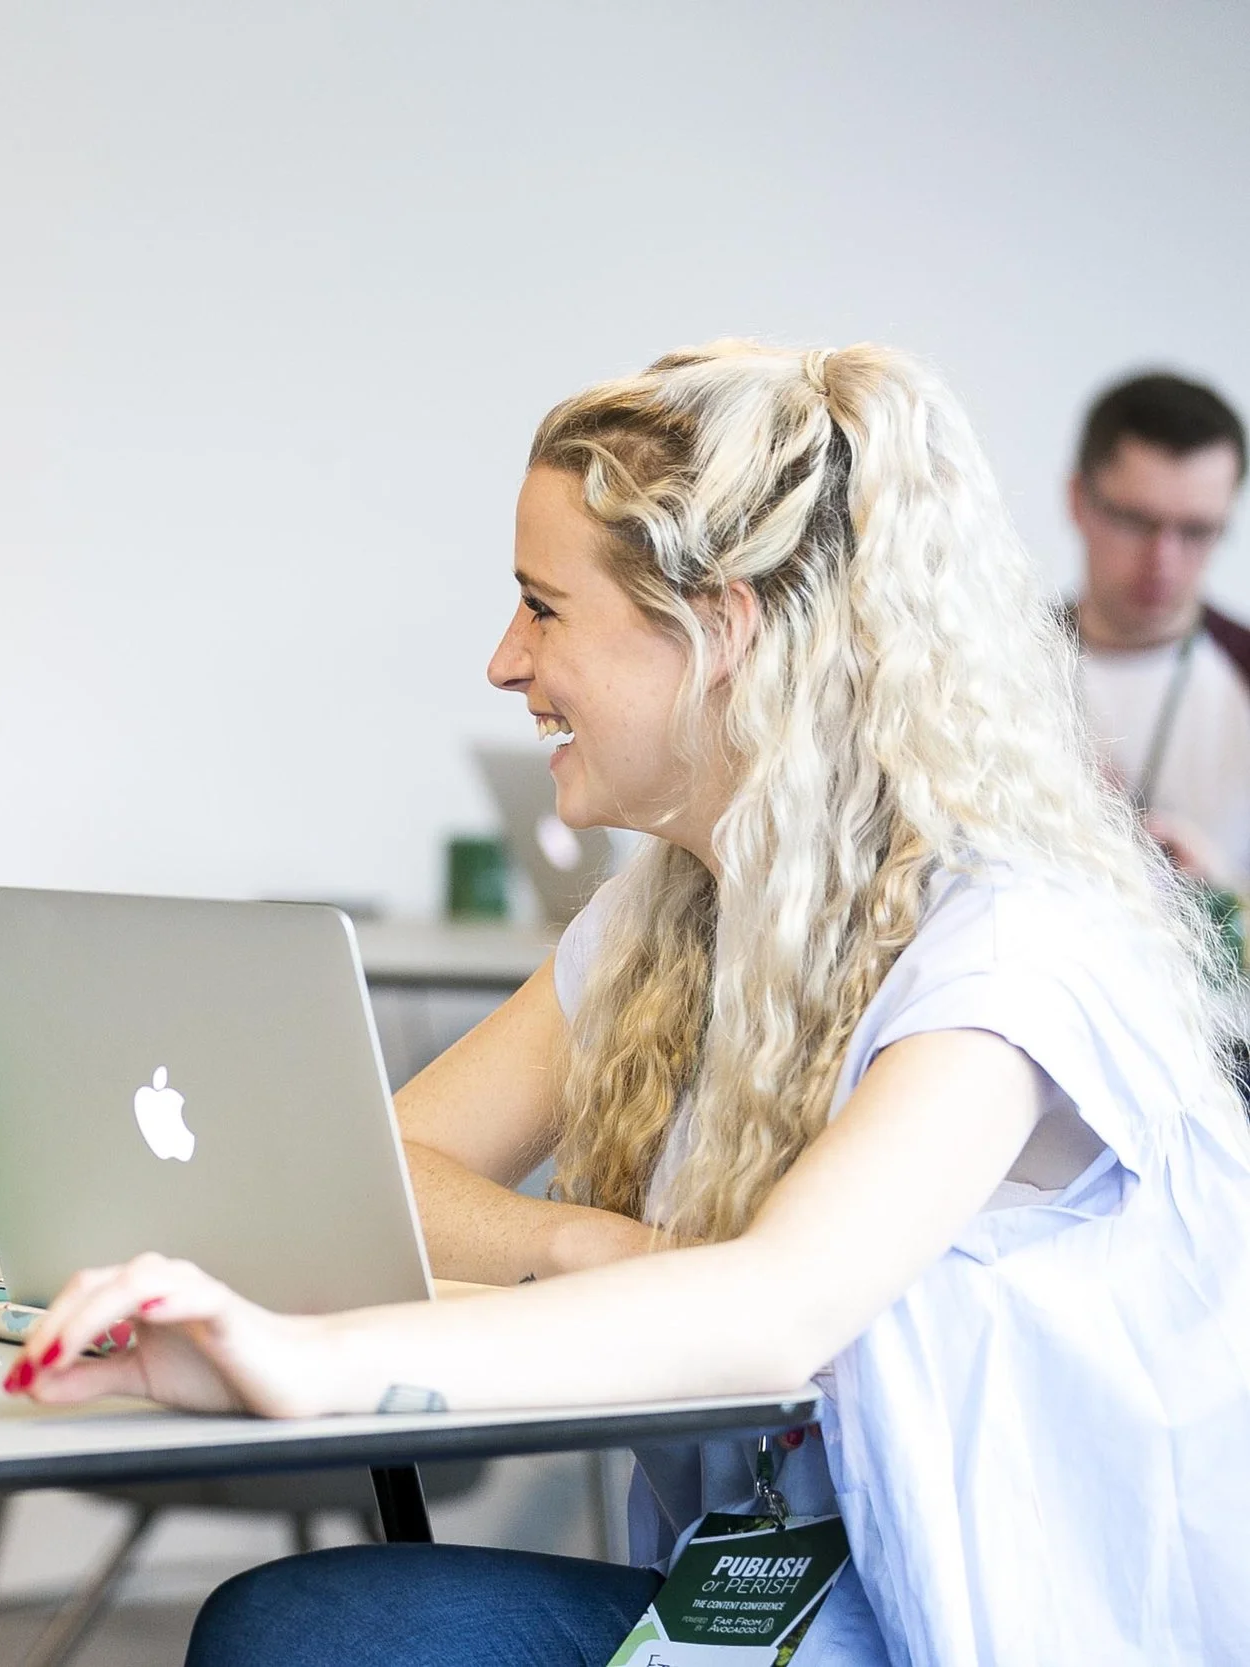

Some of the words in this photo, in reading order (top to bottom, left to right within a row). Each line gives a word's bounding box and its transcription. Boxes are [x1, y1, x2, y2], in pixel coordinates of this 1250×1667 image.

[711, 1555, 813, 1578] PUBLISH
[701, 1580, 725, 1593] or
[724, 1577, 800, 1595] PERISH
[692, 1598, 708, 1609] THE
[706, 1600, 741, 1610] CONTENT
[739, 1601, 787, 1611] CONFERENCE
[734, 1616, 762, 1626] FROM
[707, 1623, 758, 1634] AVOCADOS
